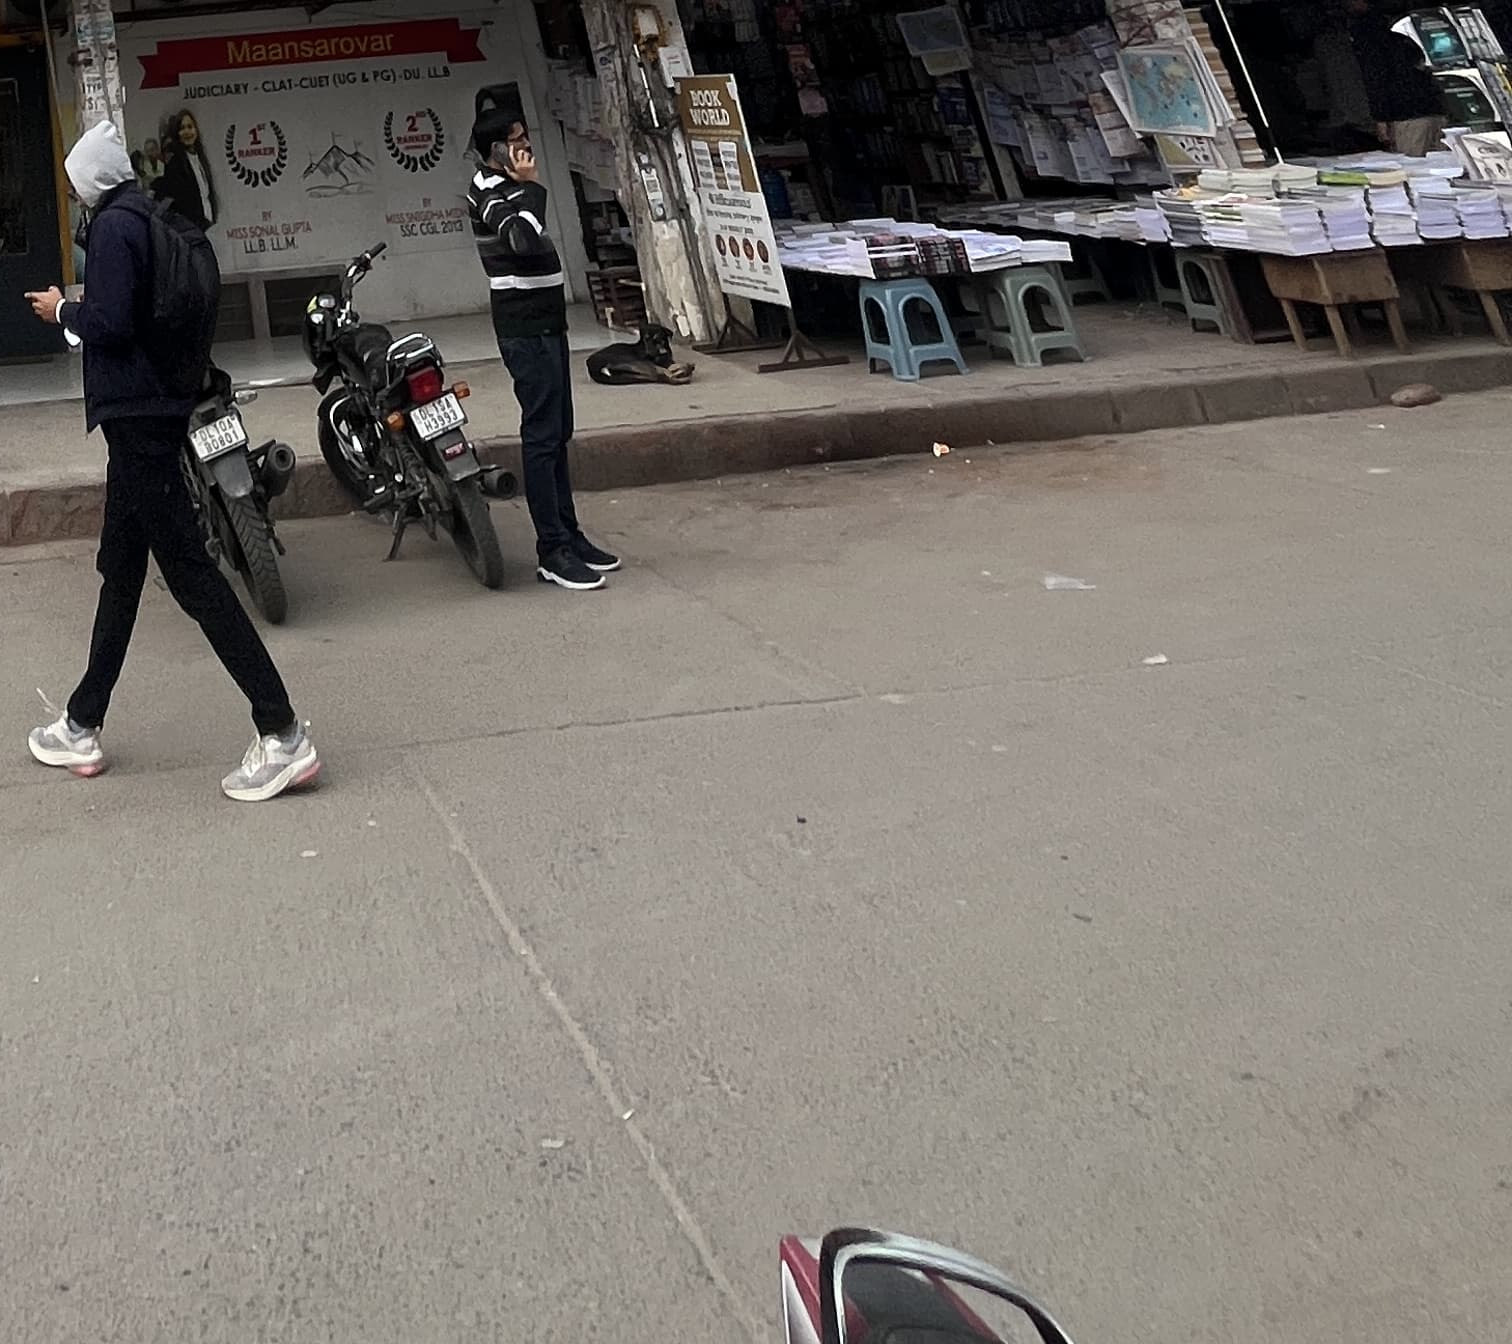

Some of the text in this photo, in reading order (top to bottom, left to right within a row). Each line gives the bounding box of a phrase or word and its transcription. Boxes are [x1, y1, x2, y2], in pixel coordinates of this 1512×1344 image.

[225, 31, 396, 66] Maansarovar
[183, 72, 358, 100] JUDICIARY (UG
[689, 88, 722, 107] BOOK
[689, 107, 731, 127] WORLD
[395, 132, 434, 146] RANKER
[237, 145, 276, 159] RANKER
[226, 220, 313, 240] MISS SONAL GUPTA
[400, 222, 441, 238] SSC CGL
[423, 409, 459, 433] H3993
